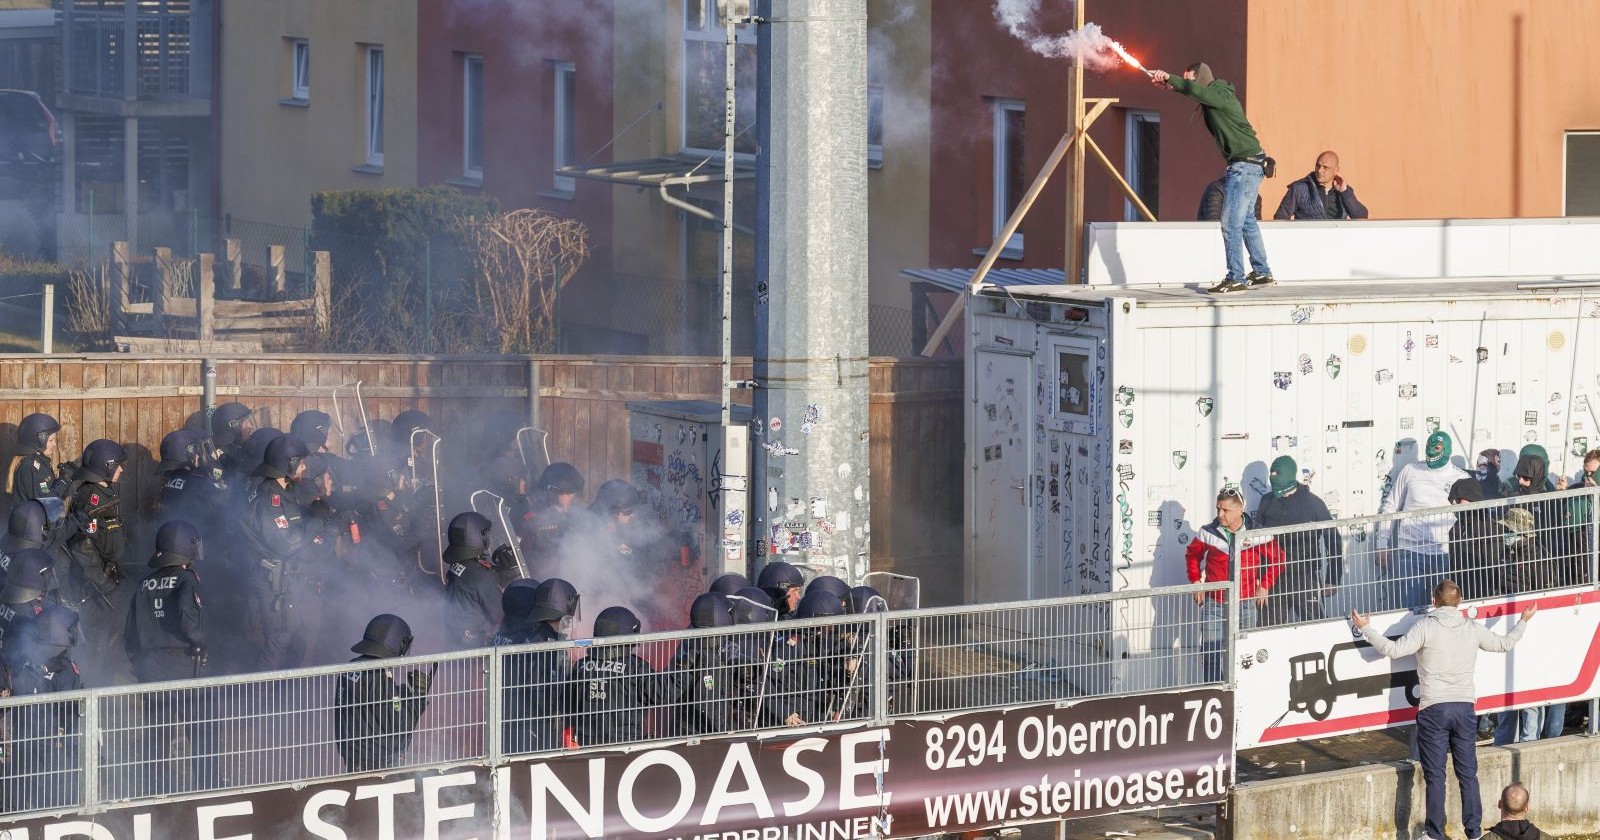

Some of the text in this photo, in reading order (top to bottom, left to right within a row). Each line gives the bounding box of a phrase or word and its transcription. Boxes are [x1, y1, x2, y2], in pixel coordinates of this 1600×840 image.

[154, 598, 163, 610] U
[925, 697, 1223, 771] 8294 Oberrohr 76
[924, 754, 1227, 828] www.steinoase.at
